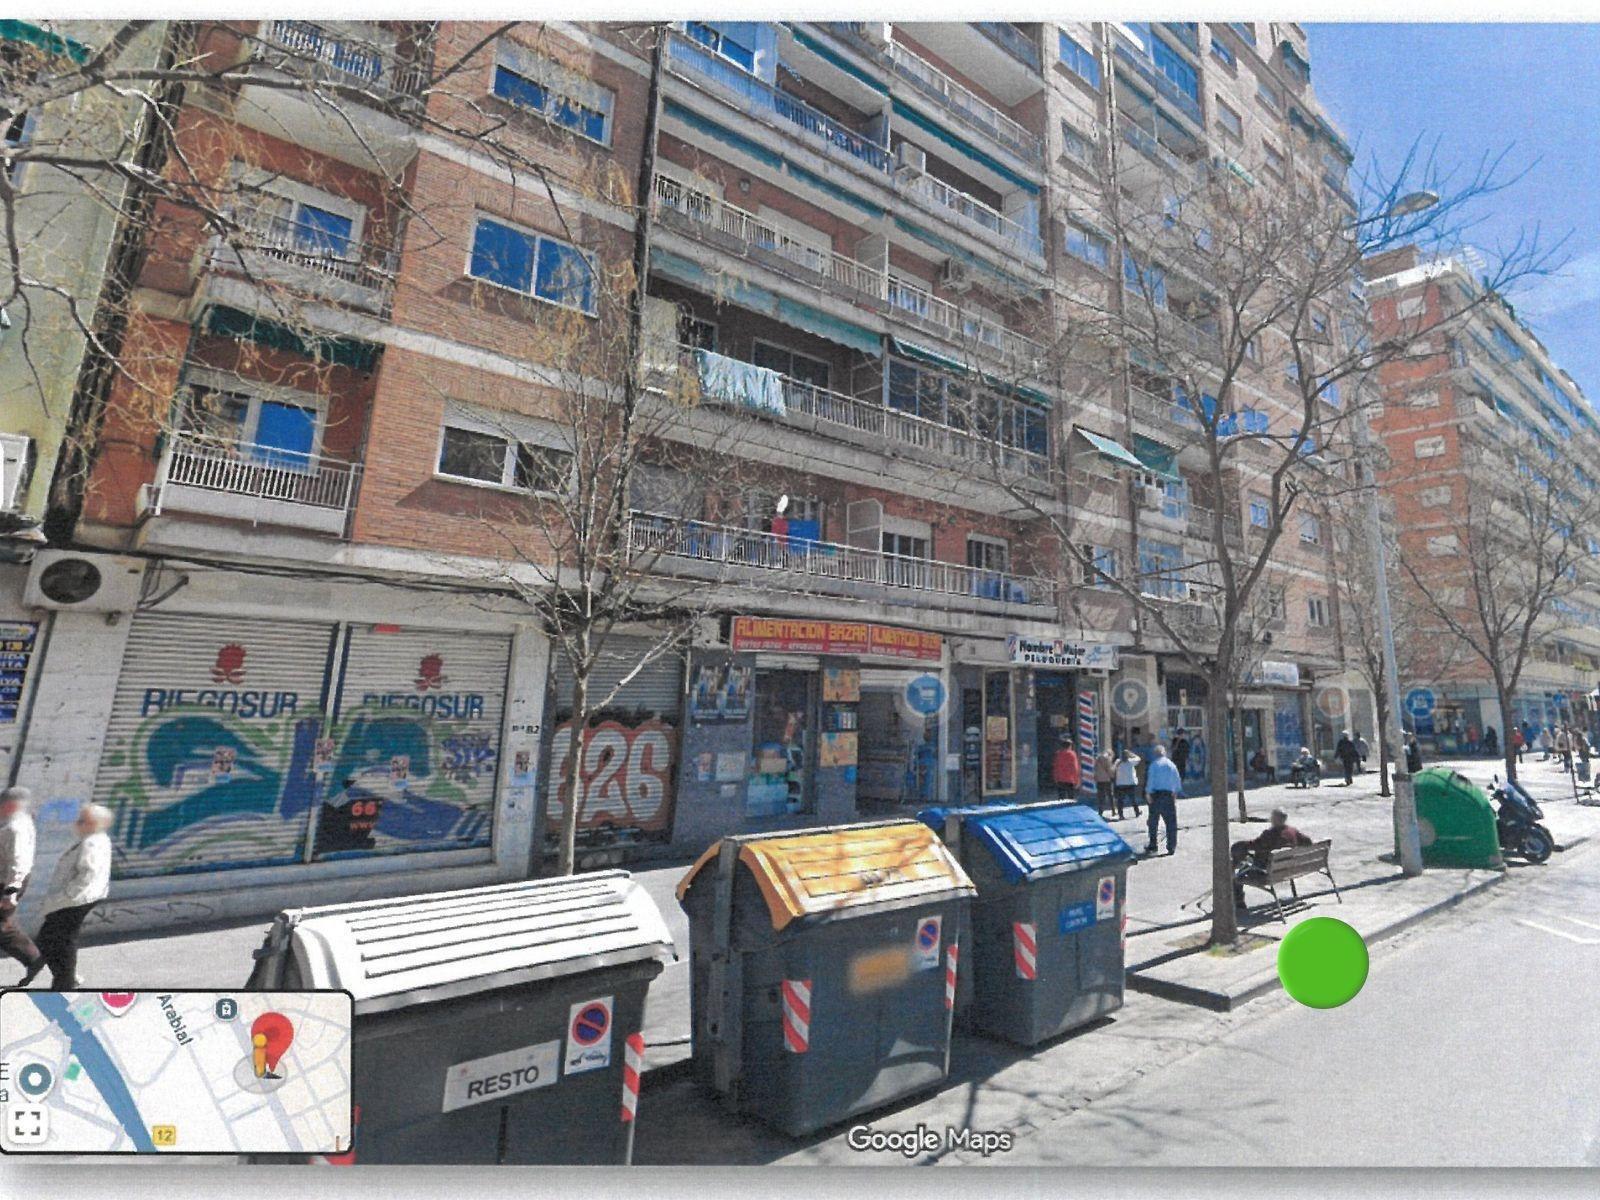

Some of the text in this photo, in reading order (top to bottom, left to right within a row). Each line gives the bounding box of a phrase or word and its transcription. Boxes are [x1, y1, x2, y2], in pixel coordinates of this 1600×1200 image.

[829, 624, 868, 642] BAZAR
[141, 687, 298, 718] RIEGOSUR
[466, 1065, 540, 1100] RESTO
